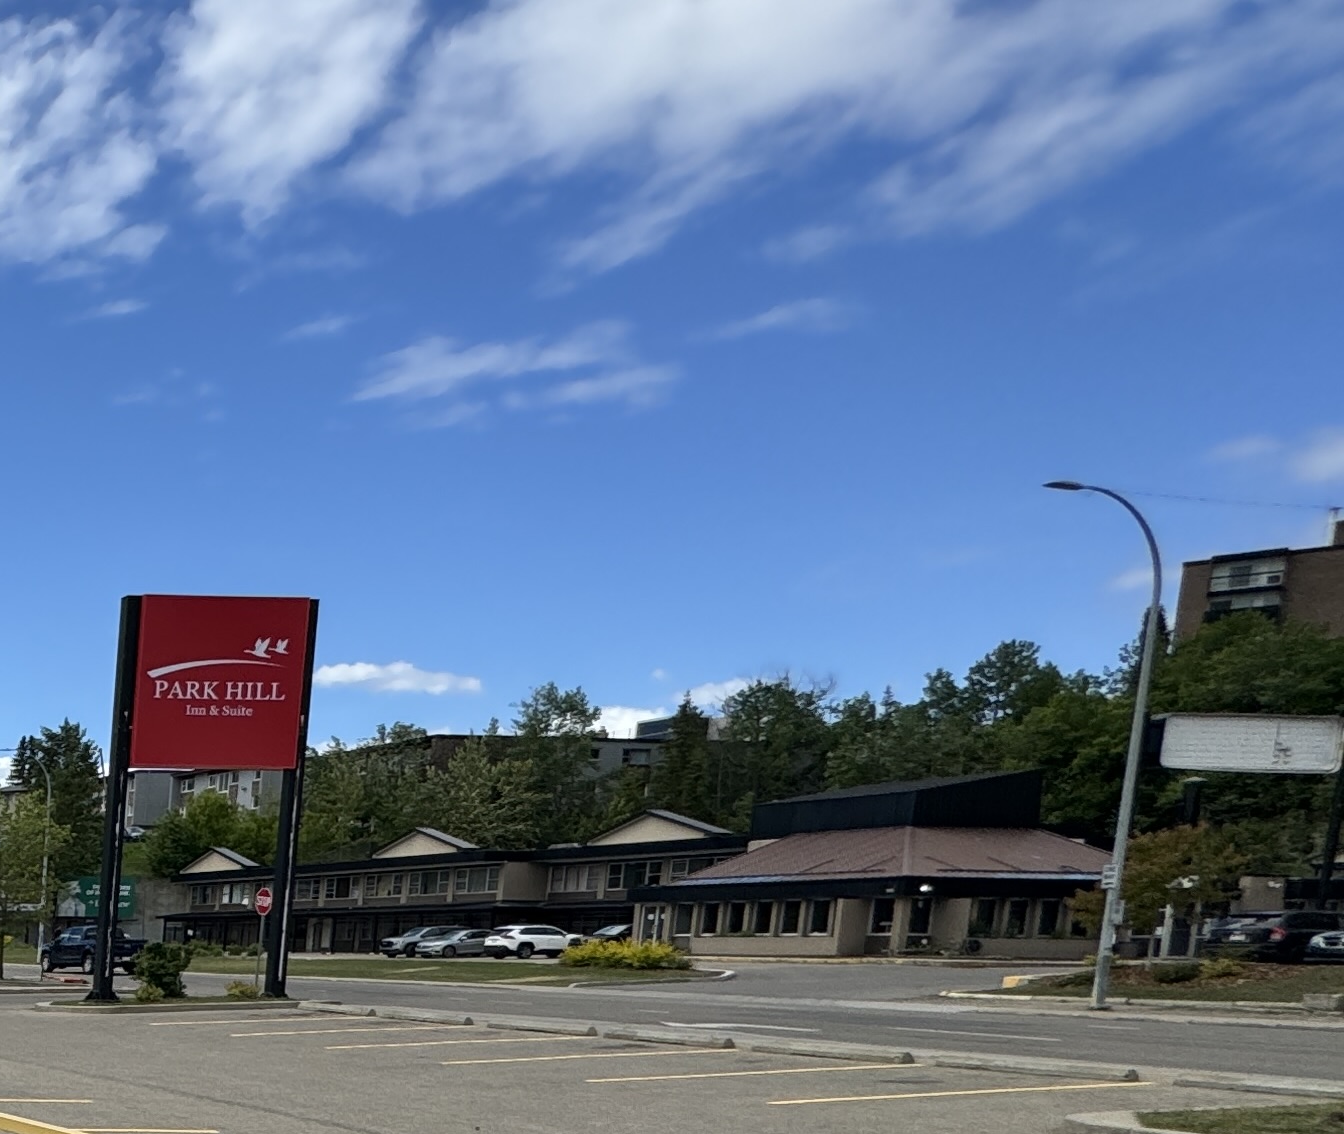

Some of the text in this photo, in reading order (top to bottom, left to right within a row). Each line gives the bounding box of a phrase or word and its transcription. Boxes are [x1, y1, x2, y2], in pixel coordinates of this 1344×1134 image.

[153, 680, 286, 701] PARK HILL
[185, 704, 253, 717] Inn & Suite
